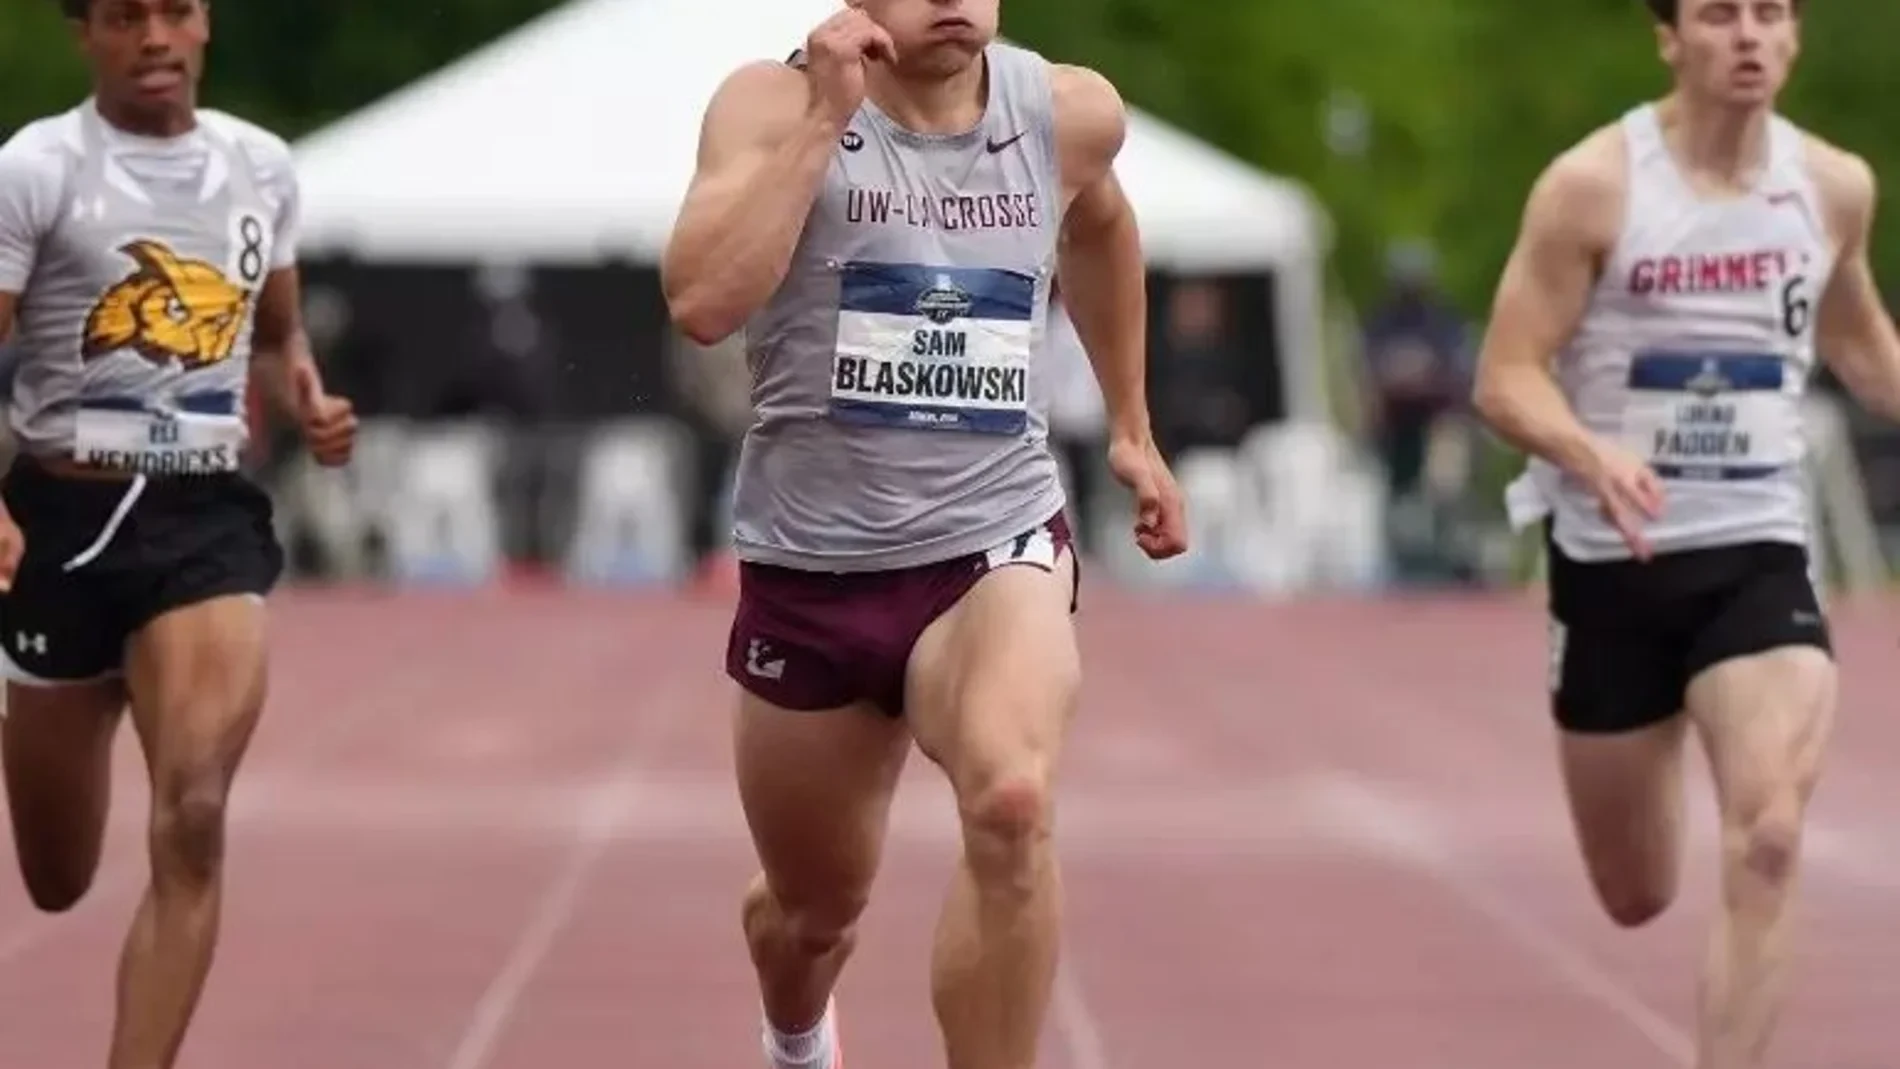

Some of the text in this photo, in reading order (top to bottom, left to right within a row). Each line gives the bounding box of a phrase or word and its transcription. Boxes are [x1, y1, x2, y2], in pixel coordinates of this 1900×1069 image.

[240, 213, 262, 282] 8
[1629, 250, 1811, 295] GRINNE
[1783, 275, 1808, 337] 6
[912, 329, 967, 357] SAM
[836, 357, 1026, 403] BLASKOWSKI
